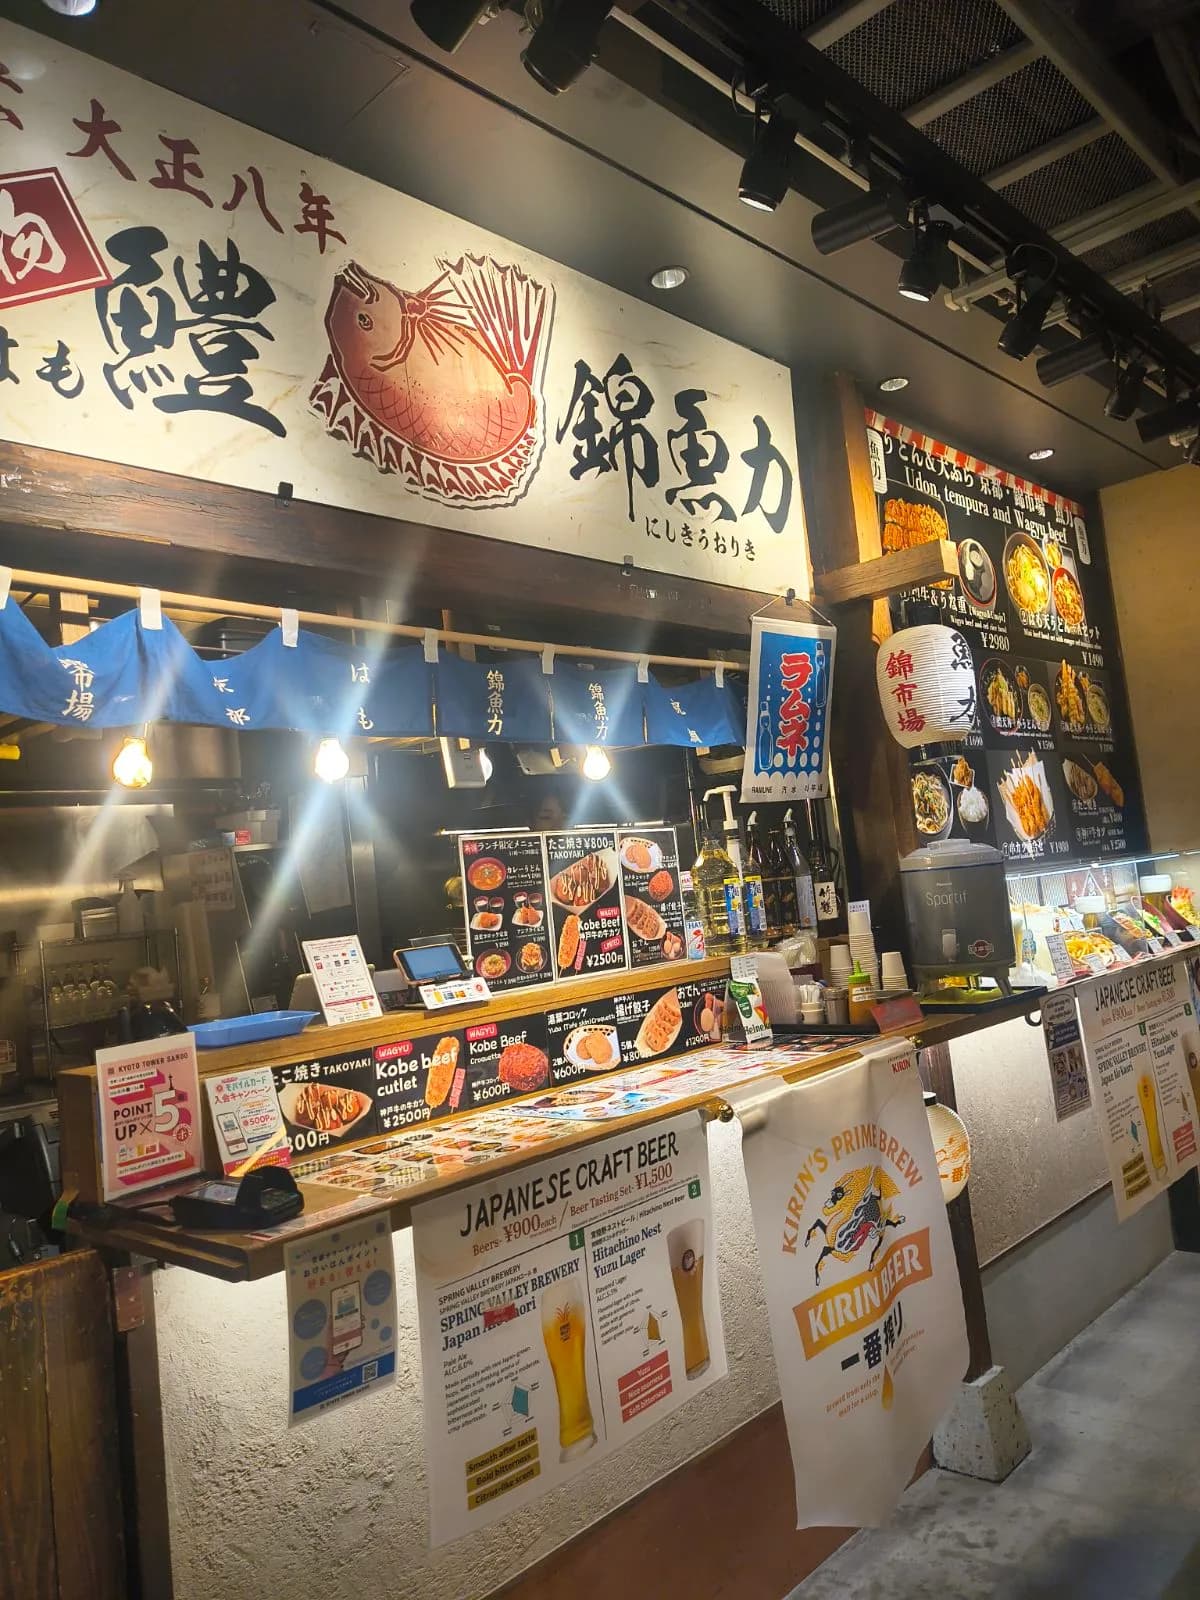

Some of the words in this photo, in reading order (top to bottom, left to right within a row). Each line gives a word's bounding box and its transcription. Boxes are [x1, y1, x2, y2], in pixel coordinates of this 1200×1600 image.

[66, 98, 347, 255] 大正八年
[556, 353, 793, 534] 錦魚力
[904, 466, 941, 500] Udon,
[944, 484, 990, 516] tempura
[993, 506, 1011, 524] and
[1013, 508, 1046, 540] Wagyu
[1047, 522, 1067, 544] beef
[645, 516, 756, 562] にしきうおりき
[980, 632, 1009, 651] ¥2980
[350, 662, 374, 730] はも
[486, 669, 504, 736] 錦魚力
[777, 652, 815, 758] ラムネ
[885, 650, 926, 732] 錦市場
[588, 682, 609, 740] 錦魚力
[549, 837, 583, 850] たこ焼き
[584, 837, 614, 849] ¥800円
[549, 850, 584, 860] TAKOYAKI
[601, 917, 620, 928] Beef
[586, 952, 624, 968] ¥2500円
[677, 984, 701, 999] おでん
[1095, 978, 1136, 1011] JAPANESE
[1137, 970, 1160, 995] CRAFT
[1160, 964, 1176, 987] BEER
[469, 1026, 495, 1038] WAGYU
[469, 1039, 497, 1055] Kobe
[500, 1031, 527, 1047] Beef
[118, 1062, 140, 1073] KYOTO
[142, 1057, 165, 1068] TOWER
[323, 1058, 371, 1076] TAKOYAKI
[376, 1057, 418, 1079] Kobe
[421, 1051, 457, 1070] beef
[378, 1044, 410, 1058] WAGYU
[892, 1058, 911, 1075] KIRIN
[226, 1077, 267, 1092] モバイルカード
[377, 1076, 418, 1097] cutlet
[553, 1064, 586, 1080] ¥600円
[215, 1085, 271, 1104] 入会キャンペーン
[379, 1099, 425, 1117] 神戸牛の牛カツ
[473, 1083, 510, 1101] ¥600円
[113, 1102, 153, 1121] POINT
[115, 1124, 137, 1141] UP
[154, 1088, 180, 1134] 5
[383, 1106, 431, 1129] ¥2500円
[460, 1168, 573, 1237] JAPANESE
[576, 1146, 634, 1190] CRAFT
[637, 1131, 679, 1169] BEER
[569, 1203, 589, 1217] Beer
[590, 1189, 619, 1209] Tasting
[635, 1163, 673, 1190] ¥1,500
[782, 1147, 829, 1254] KIRIN'S
[831, 1122, 877, 1161] PRIME
[878, 1127, 923, 1188] BREW
[592, 1233, 641, 1263] Hitachino
[641, 1222, 662, 1241] Nest
[593, 1259, 619, 1279] Yuzu
[620, 1247, 646, 1268] Lager
[438, 1288, 466, 1305] SPRING
[466, 1277, 491, 1292] VALLEY
[491, 1263, 521, 1283] BREWERY
[487, 1280, 529, 1308] VALLEY
[531, 1258, 580, 1291] BREWERY
[808, 1276, 881, 1343] KIRIN
[880, 1244, 923, 1301] BEER
[442, 1324, 481, 1351] Japan
[840, 1300, 904, 1371] 一番搾り
[468, 1454, 498, 1473] Smooth
[498, 1444, 516, 1458] after
[517, 1434, 535, 1447] taste
[476, 1471, 494, 1486] Bold
[494, 1453, 531, 1477] bitterness
[475, 1480, 514, 1504] Citrus-like
[514, 1469, 534, 1484] scent
